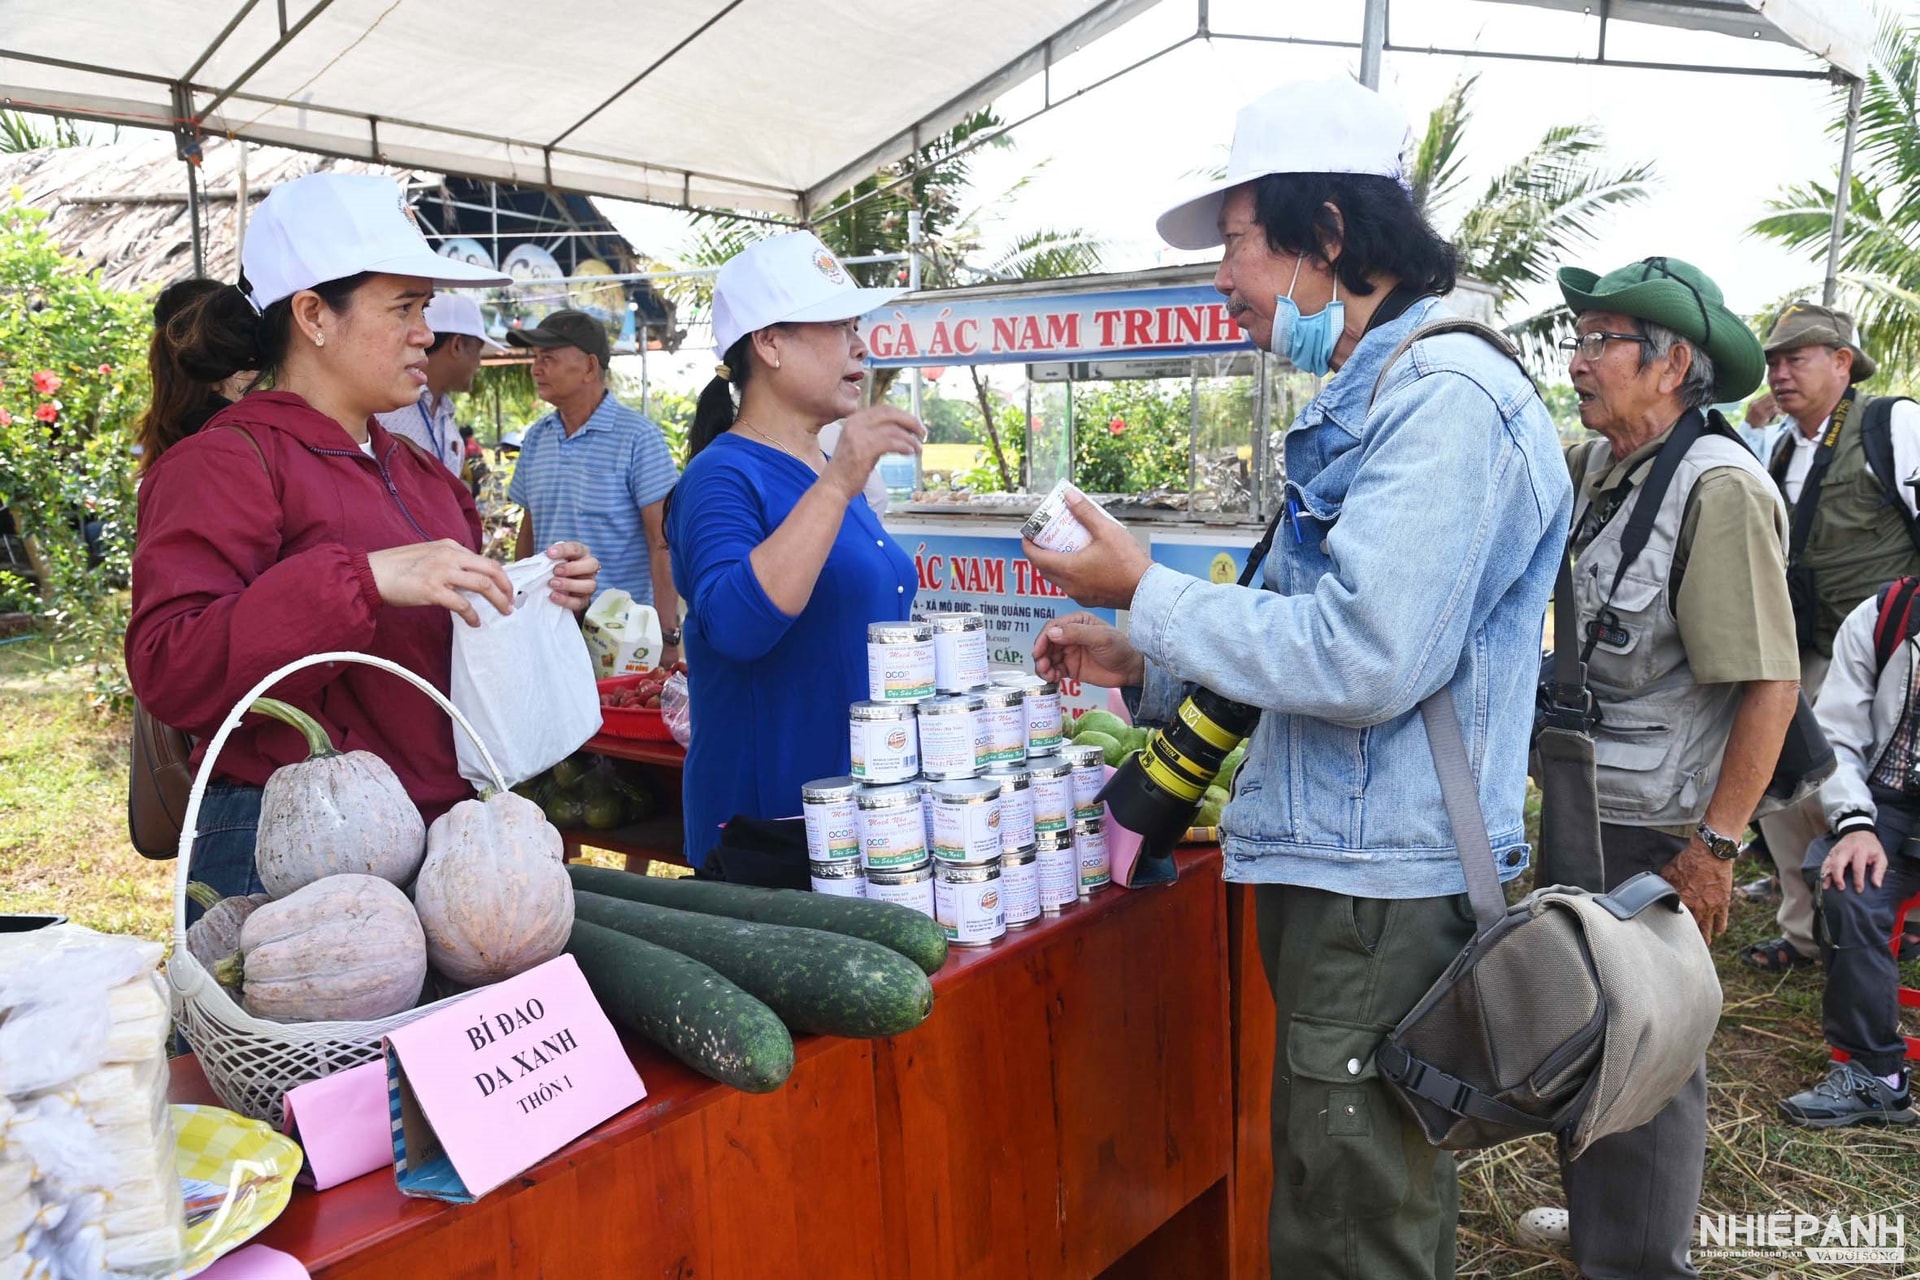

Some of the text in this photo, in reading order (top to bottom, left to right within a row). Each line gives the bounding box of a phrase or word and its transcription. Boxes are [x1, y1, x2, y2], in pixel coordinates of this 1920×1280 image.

[869, 304, 1242, 357] GÀ ÁC NAM TRINH
[950, 556, 1005, 594] NAM
[954, 599, 972, 613] ĐỨC
[979, 600, 999, 615] TỈNH
[1002, 603, 1031, 618] QUẢNG
[996, 621, 1013, 632] 097
[1014, 622, 1030, 633] 711
[994, 645, 1024, 664] CẤP:
[885, 670, 910, 679] OCOP
[828, 828, 854, 839] OCOP
[866, 838, 890, 847] OCOP
[1082, 857, 1104, 868] OCOP
[465, 998, 545, 1052] BÍ ĐAO
[474, 1028, 578, 1098] DA XANH
[516, 1074, 574, 1114] THÔN 1
